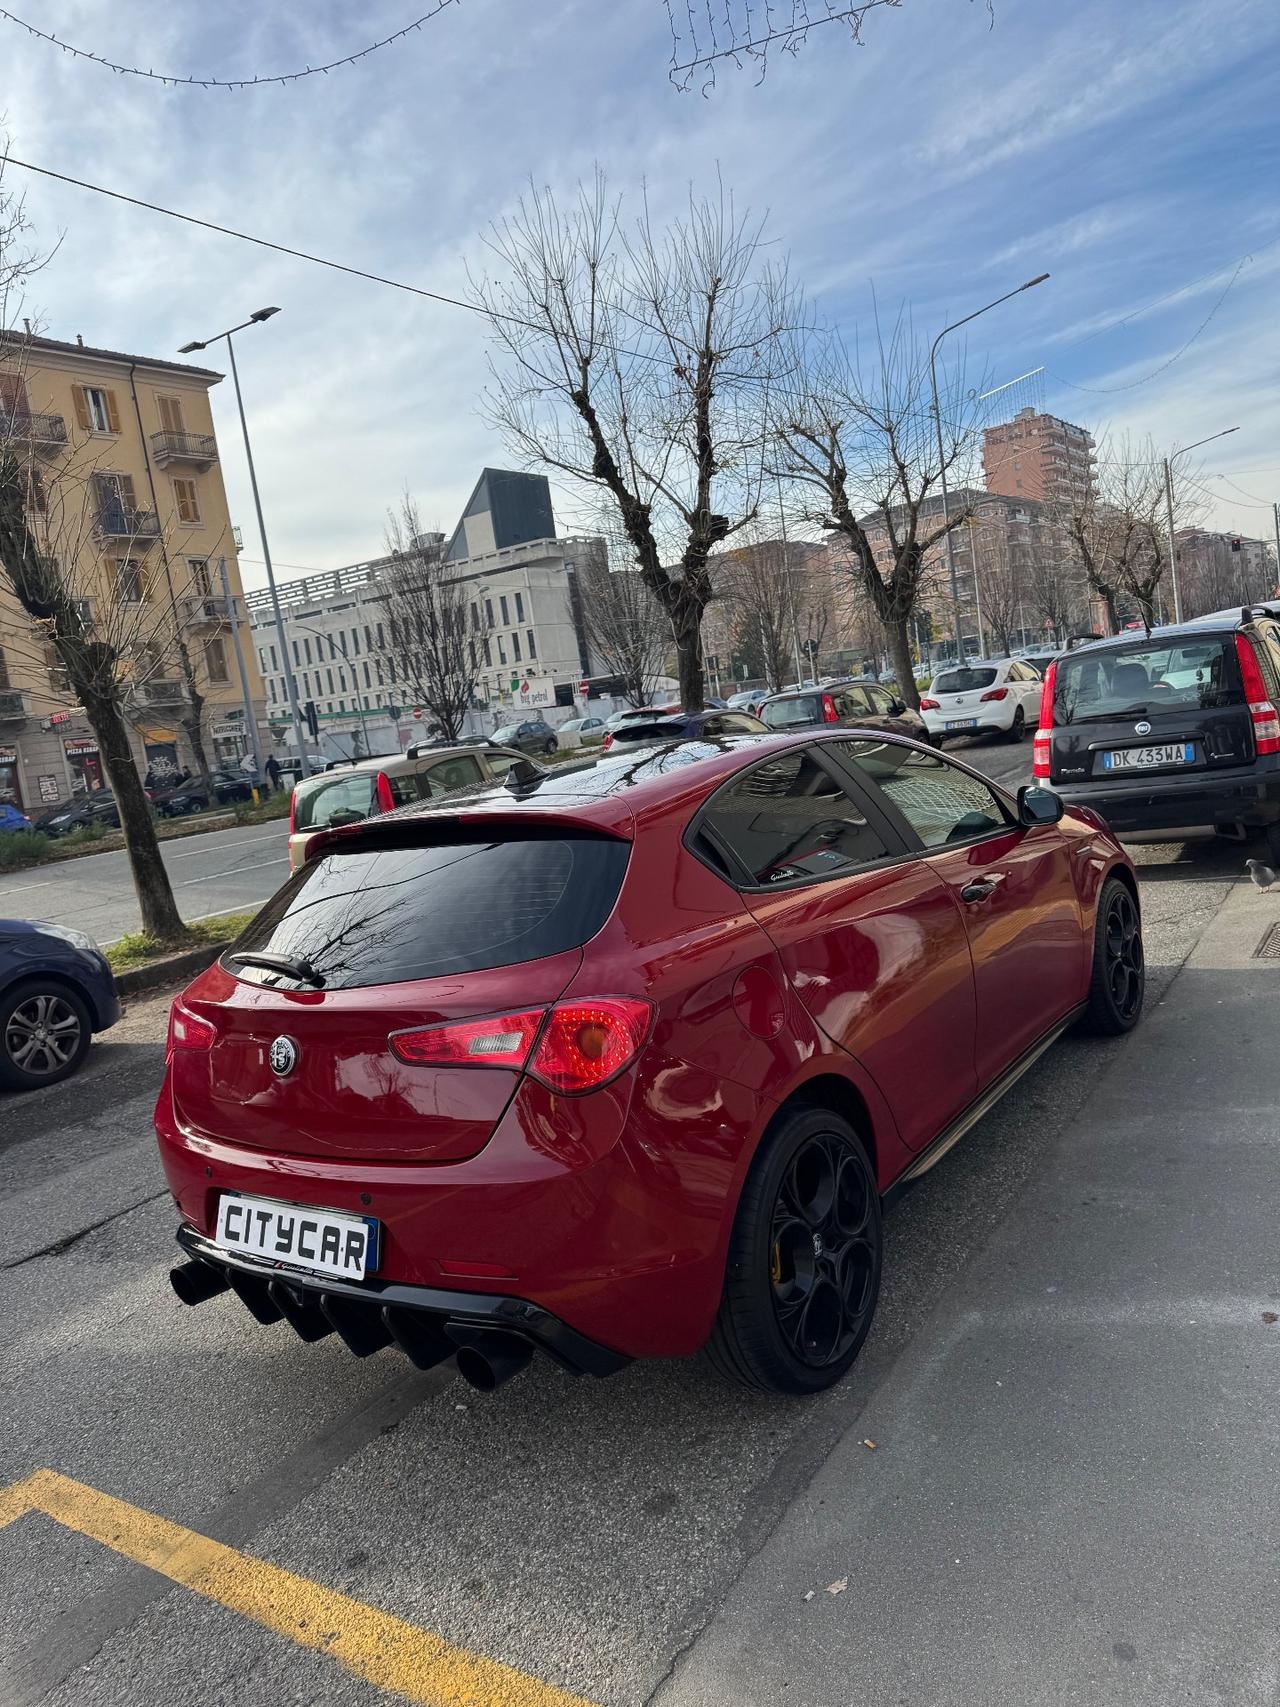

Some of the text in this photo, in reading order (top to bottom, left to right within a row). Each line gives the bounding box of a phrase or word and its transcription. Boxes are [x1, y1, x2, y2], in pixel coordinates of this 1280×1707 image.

[1113, 745, 1183, 768] DK 433WA
[224, 1205, 365, 1272] CITYCAR
